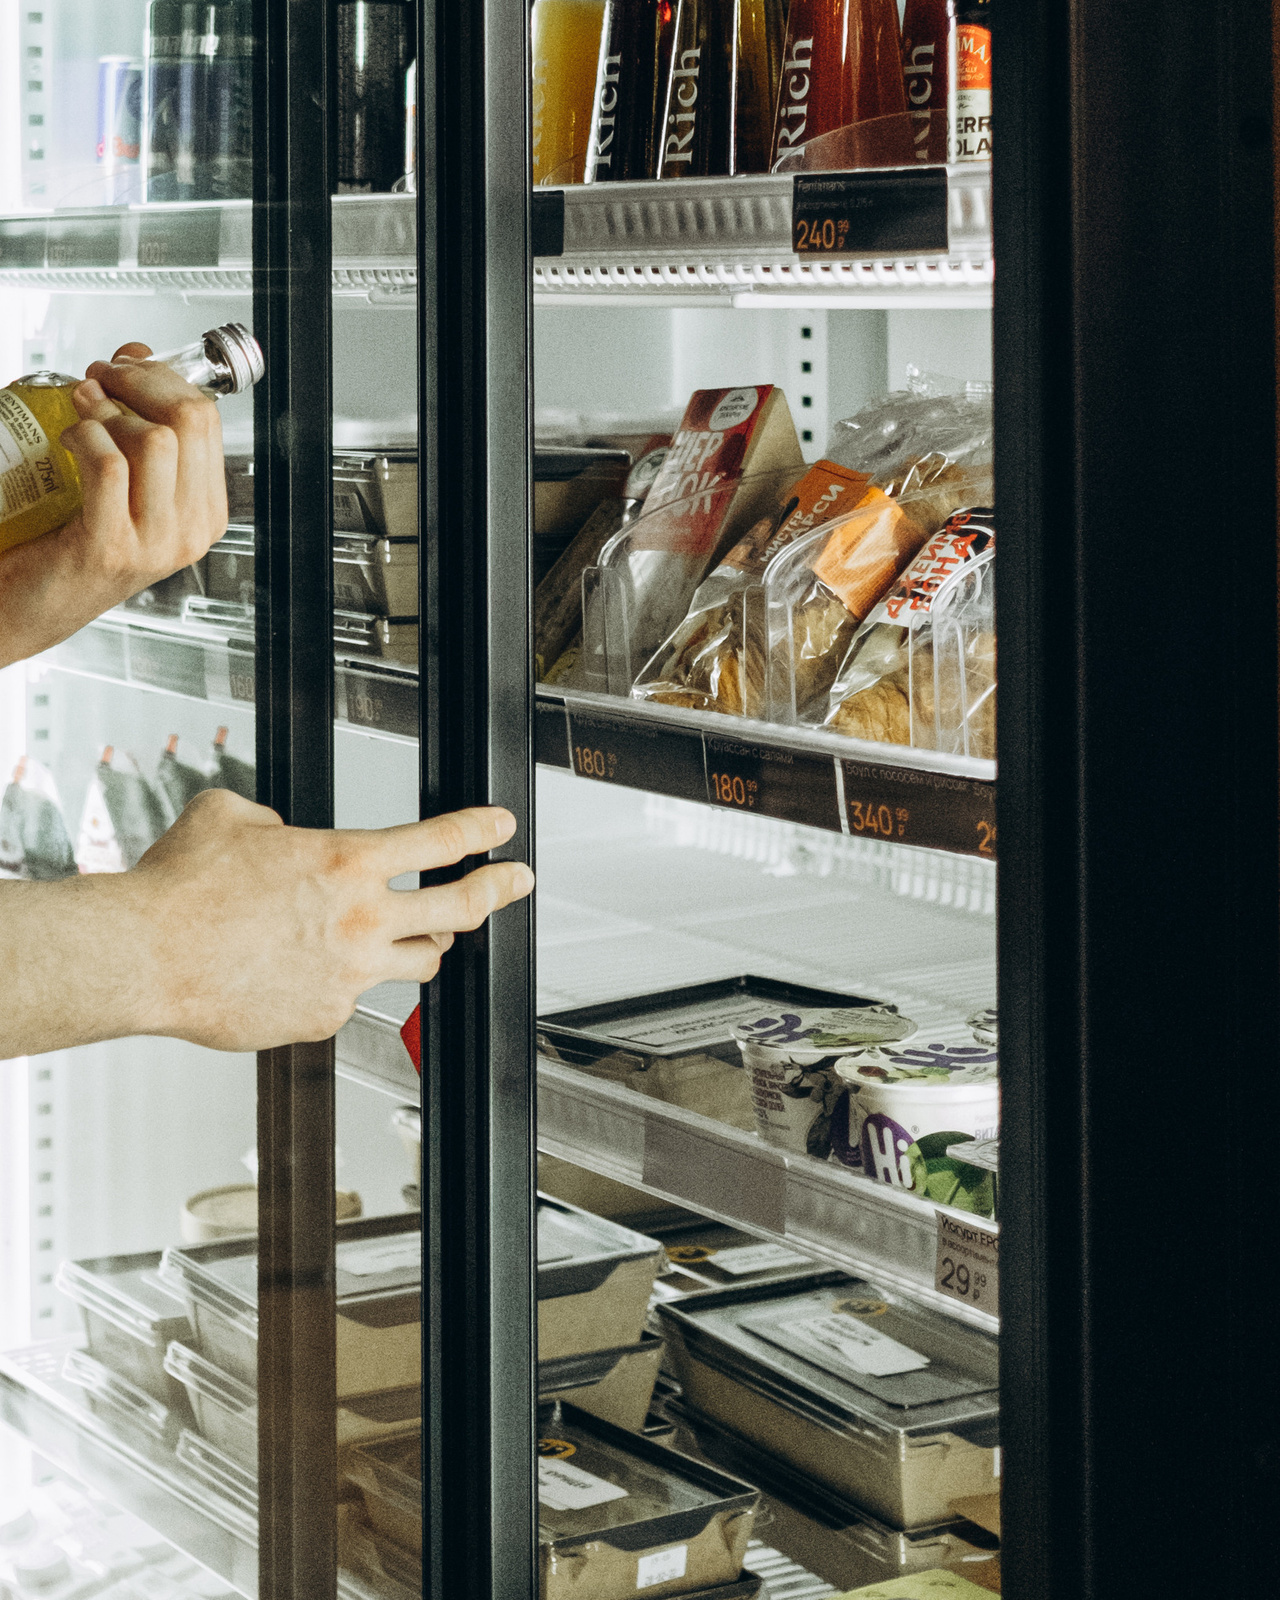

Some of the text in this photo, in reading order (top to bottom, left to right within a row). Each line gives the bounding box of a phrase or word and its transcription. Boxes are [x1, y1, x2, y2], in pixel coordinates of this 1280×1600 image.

[664, 45, 702, 165] Rich
[777, 35, 813, 164] Rich
[796, 218, 835, 249] 240
[575, 746, 605, 777] 180
[712, 773, 745, 805] 180
[850, 800, 893, 836] 340
[866, 1121, 914, 1189] Hi
[941, 1215, 978, 1244] Йогурт
[941, 1257, 970, 1296] 29
